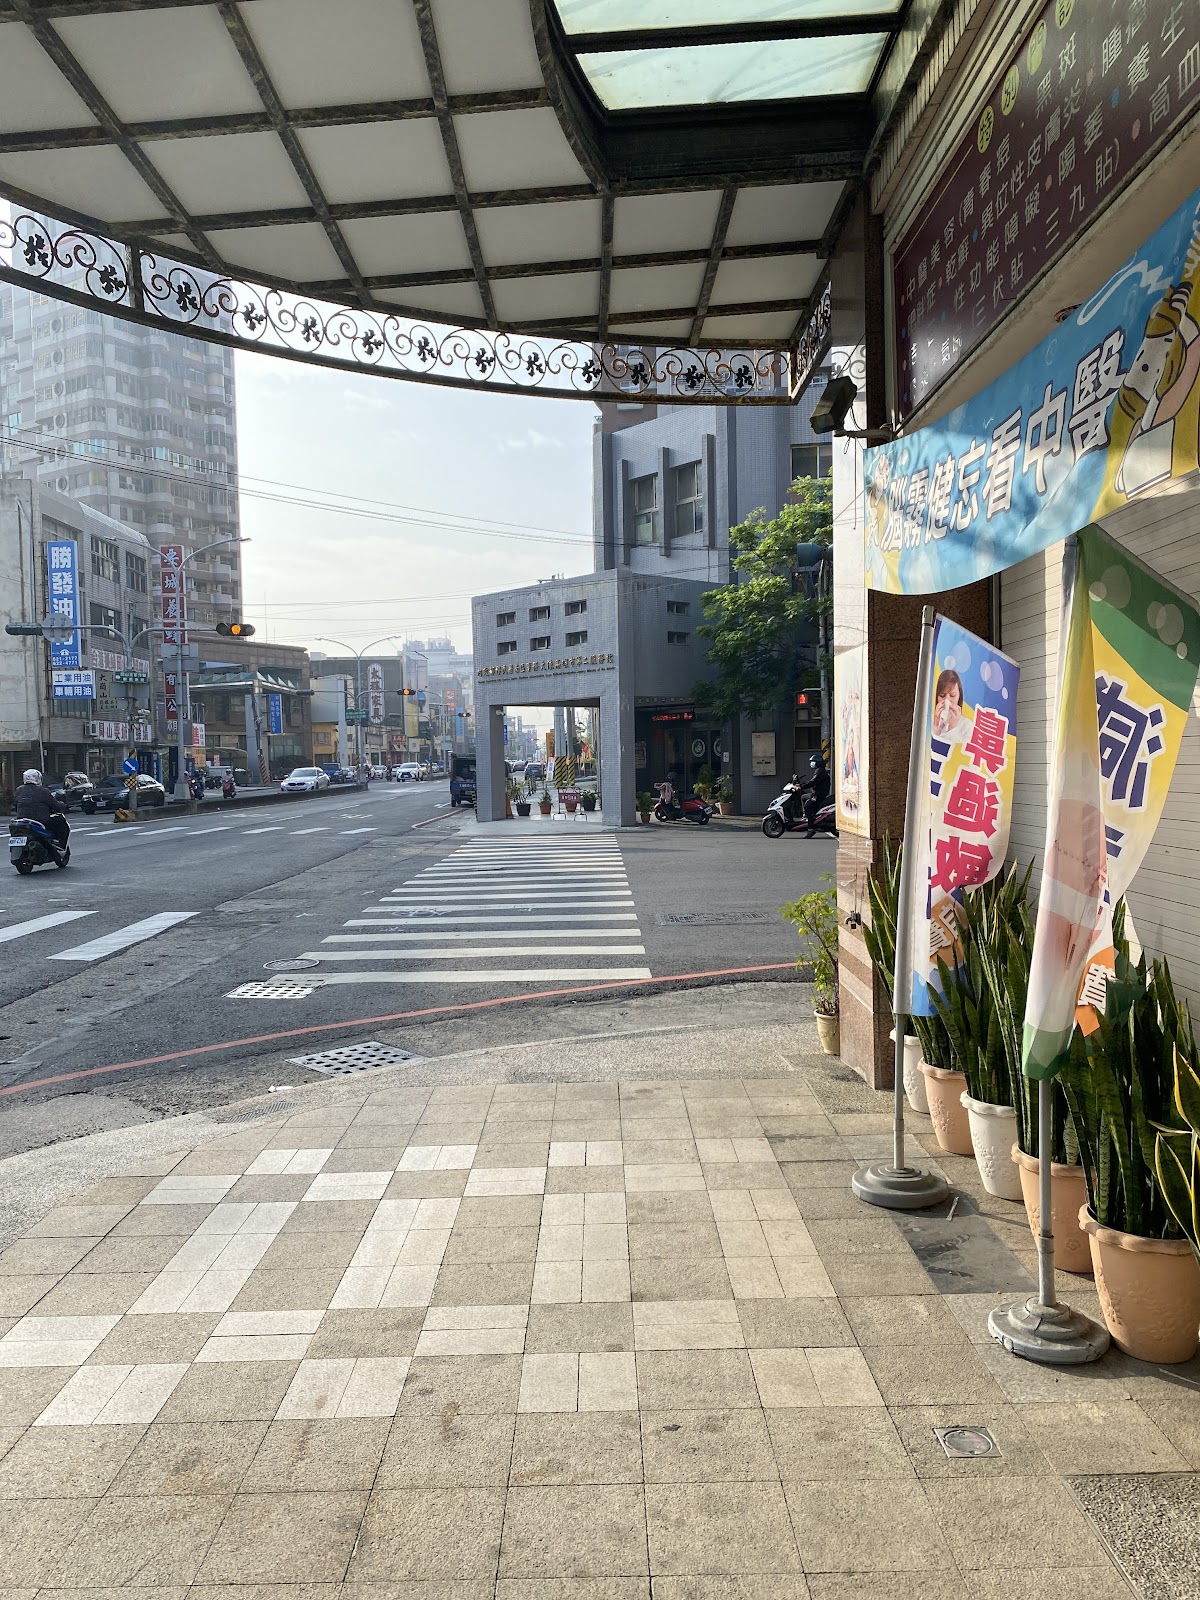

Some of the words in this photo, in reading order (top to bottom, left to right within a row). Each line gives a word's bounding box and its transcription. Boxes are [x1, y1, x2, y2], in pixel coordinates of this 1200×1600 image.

[881, 326, 1127, 553] 腦霧健忘看中醫
[51, 546, 74, 645] 勝發油
[54, 673, 92, 683] 工業用油
[54, 686, 92, 696] 車輛用油
